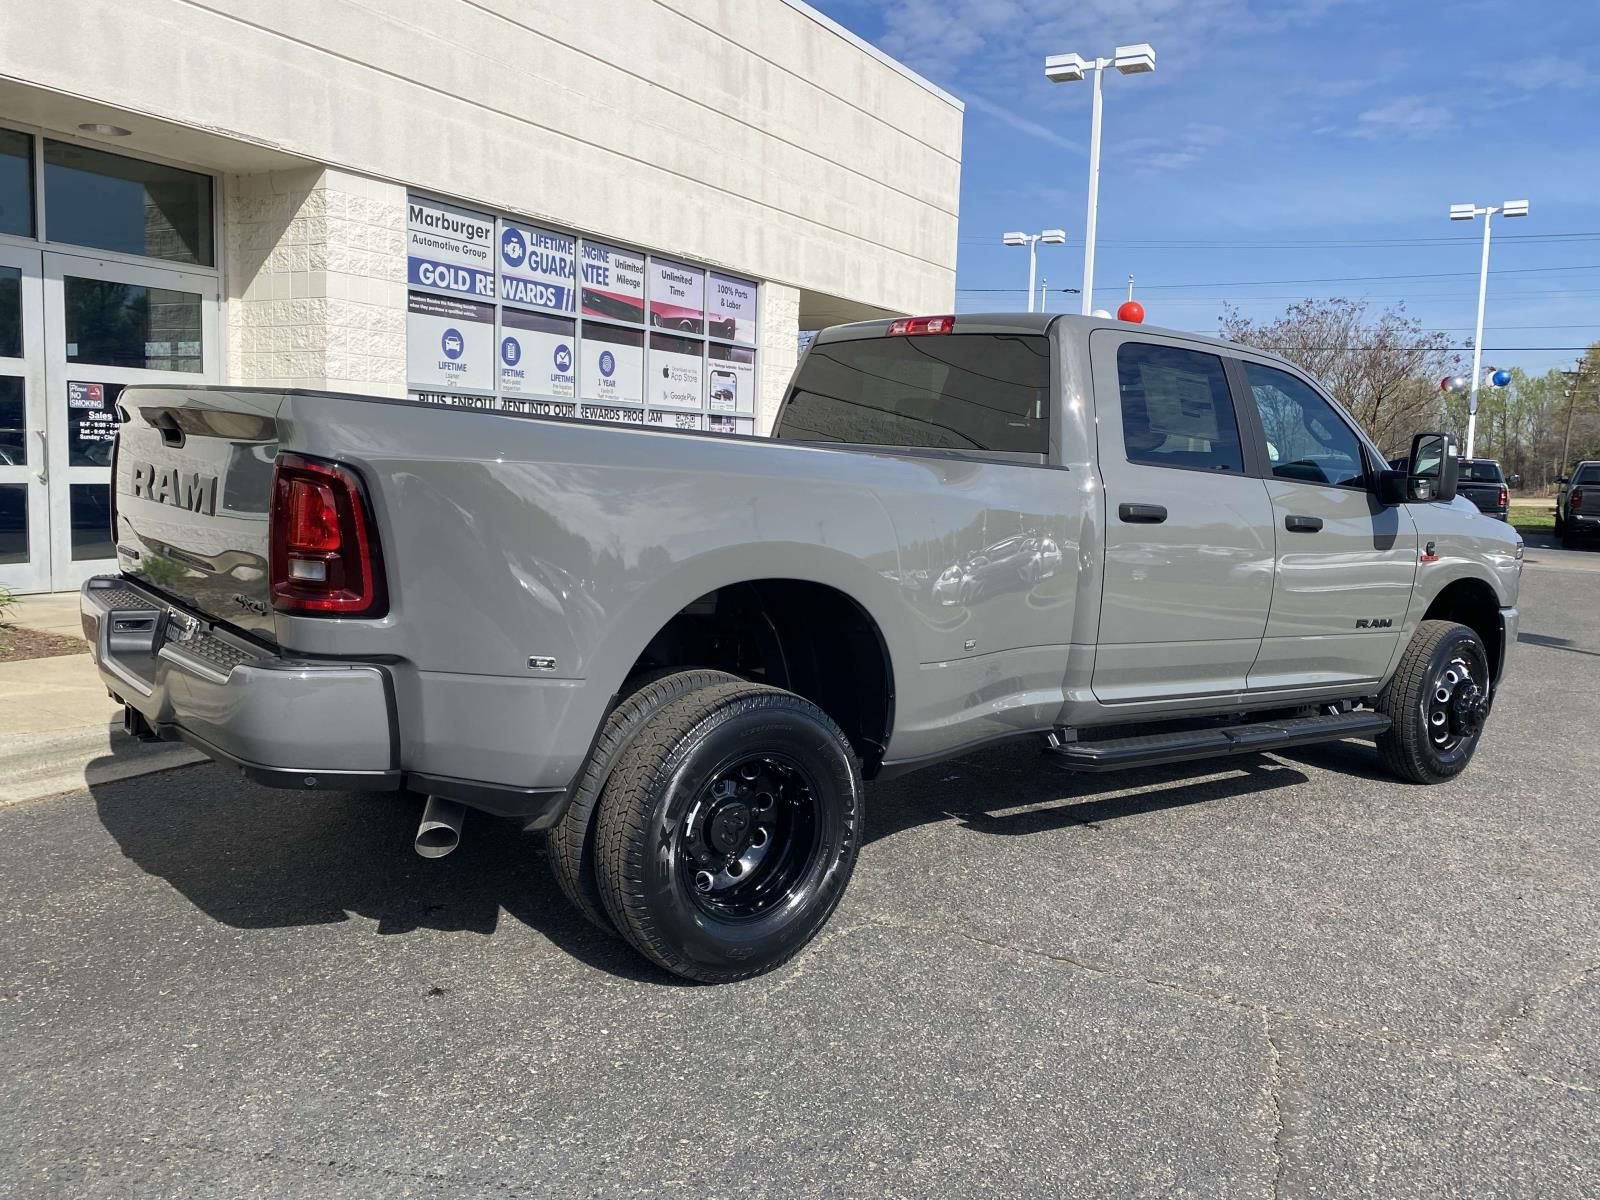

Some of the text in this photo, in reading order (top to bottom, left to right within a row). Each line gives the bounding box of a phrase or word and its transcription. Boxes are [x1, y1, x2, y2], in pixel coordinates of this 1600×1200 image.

[409, 205, 491, 240] Marburger
[412, 233, 487, 260] Automotive Group
[530, 233, 609, 264] LIFETIME ENGINE
[614, 258, 644, 274] Unlimited
[418, 262, 471, 291] GOLD
[616, 274, 641, 289] Mileage
[661, 270, 693, 286] Unlimited
[669, 285, 685, 297] Time
[717, 284, 748, 299] 100% Parts
[720, 297, 741, 310] & Labor
[438, 361, 467, 372] LIFETIME
[502, 368, 525, 379] IFETIME
[551, 373, 574, 384] LIFETIME
[603, 378, 616, 388] YEAR
[671, 372, 698, 384] App Store
[71, 399, 102, 408] SMOKING
[528, 402, 551, 415] INTO
[553, 404, 573, 417] OUR
[88, 411, 113, 421] Sales
[132, 463, 218, 517] RAM
[1356, 618, 1392, 629] RAM
